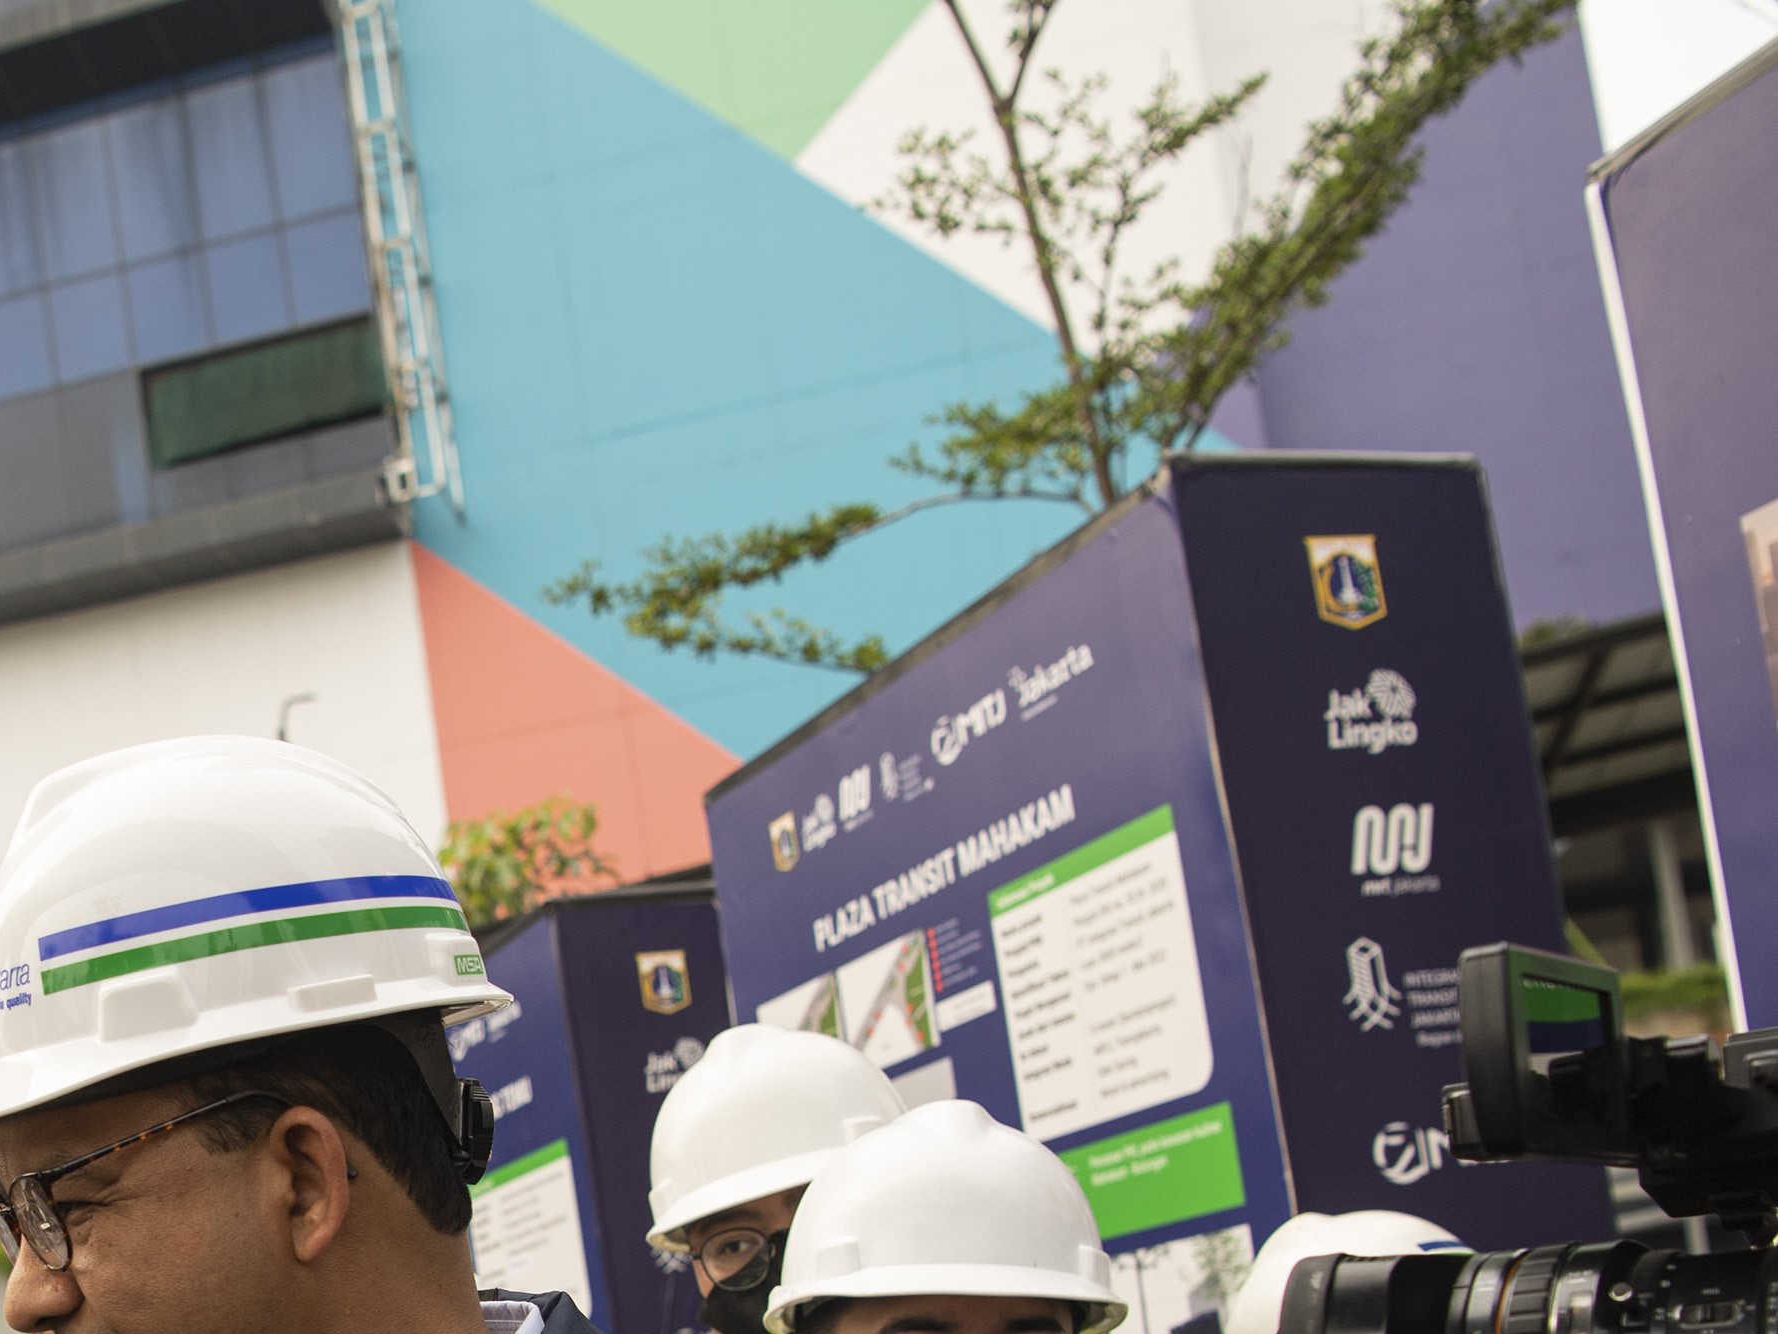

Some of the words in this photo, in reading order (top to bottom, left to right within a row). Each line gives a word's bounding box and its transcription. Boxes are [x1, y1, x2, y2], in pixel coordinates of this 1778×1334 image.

[1328, 718, 1419, 755] Lingko
[812, 894, 877, 953] PLAZA
[871, 846, 956, 921] TRANSIT
[955, 783, 1076, 878] MAHAKAM
[456, 956, 483, 974] MSA
